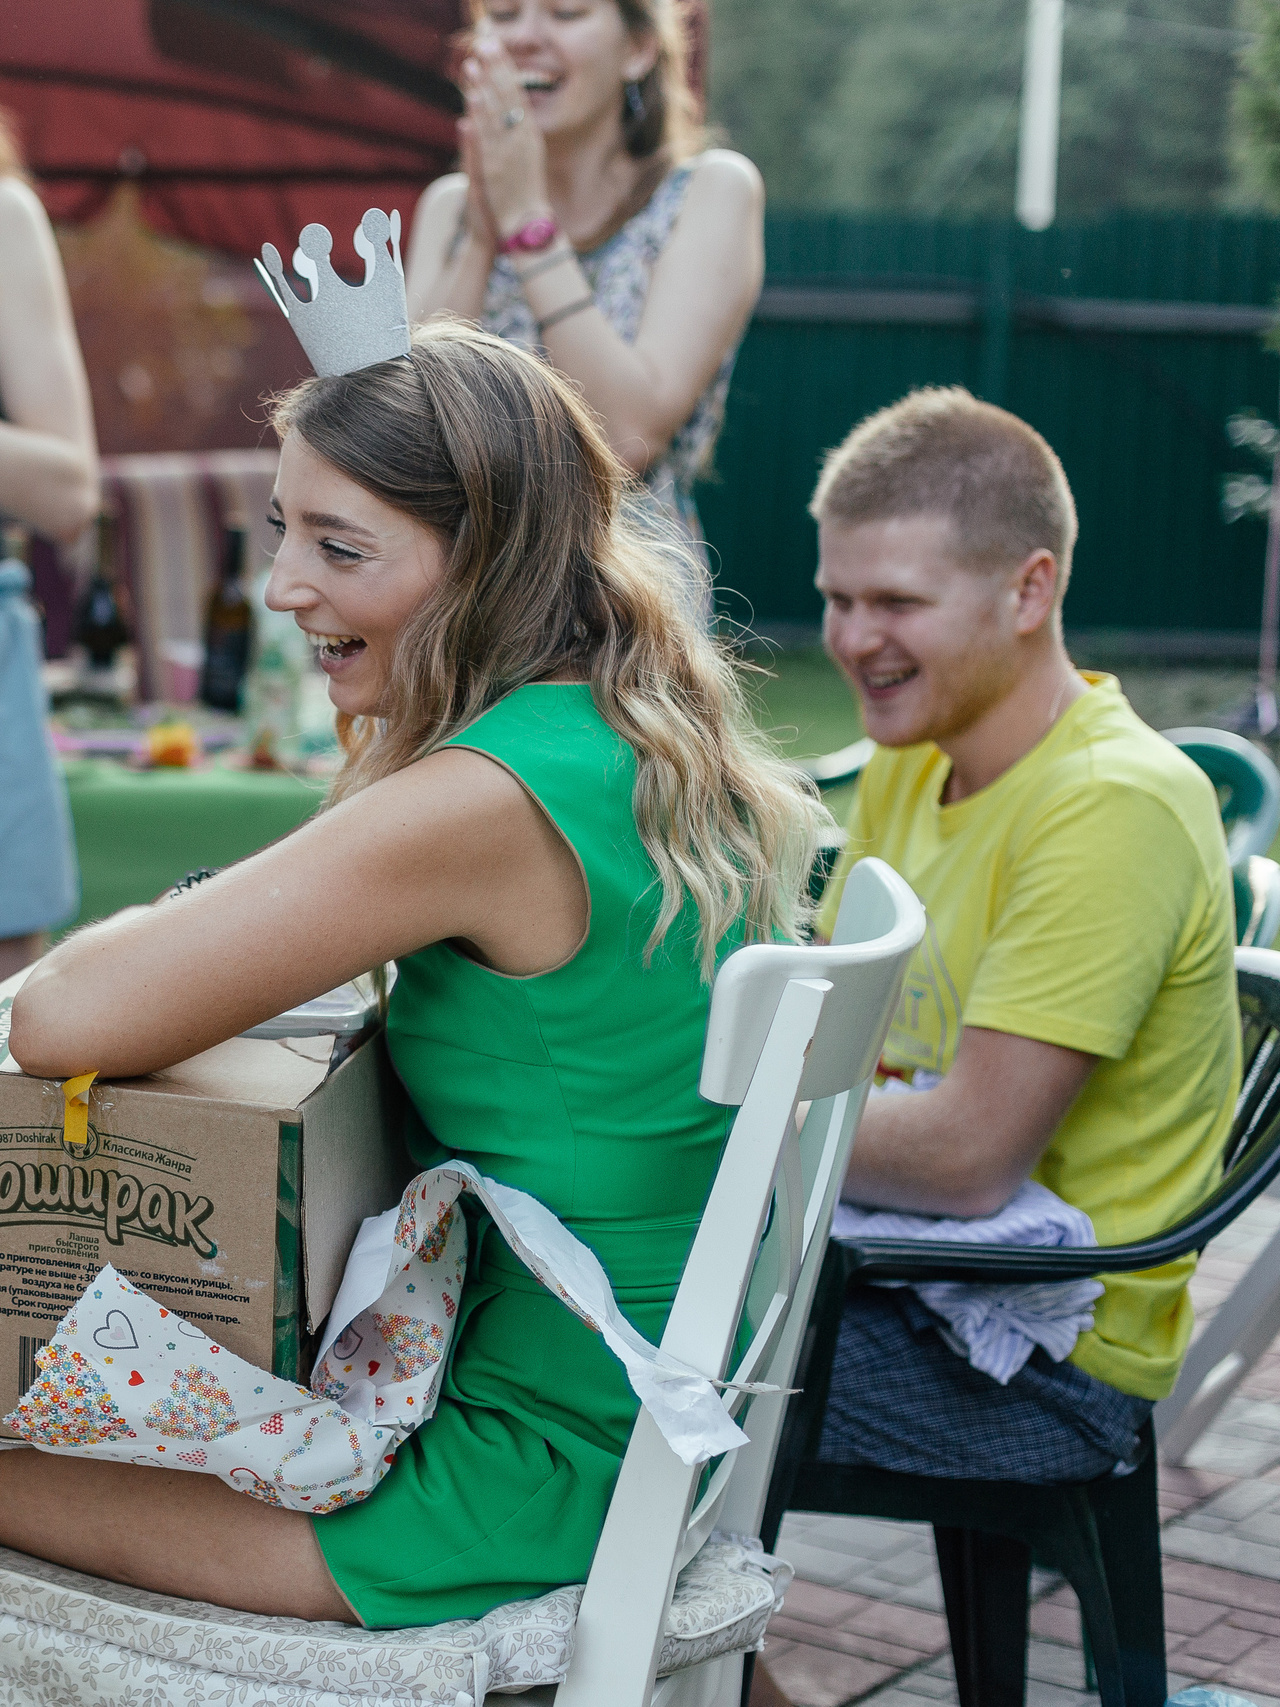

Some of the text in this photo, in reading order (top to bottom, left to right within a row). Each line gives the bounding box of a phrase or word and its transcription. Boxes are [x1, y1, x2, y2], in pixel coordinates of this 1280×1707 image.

[15, 1132, 56, 1144] Doshirak
[102, 1139, 192, 1174] Классика Жанра
[55, 1238, 100, 1252] быстрого
[69, 1232, 100, 1244] Лапша
[28, 1243, 100, 1260] приготовления
[7, 1252, 81, 1270] приготовления
[140, 1271, 152, 1280] со
[153, 1272, 189, 1284] вкусом
[190, 1278, 233, 1291] курицы.
[22, 1276, 61, 1291] воздуха
[63, 1281, 75, 1291] не
[35, 1266, 47, 1276] не
[48, 1269, 77, 1280] выше
[195, 1290, 250, 1304] влажности
[11, 1296, 36, 1308] Срок
[214, 1313, 241, 1325] таре.
